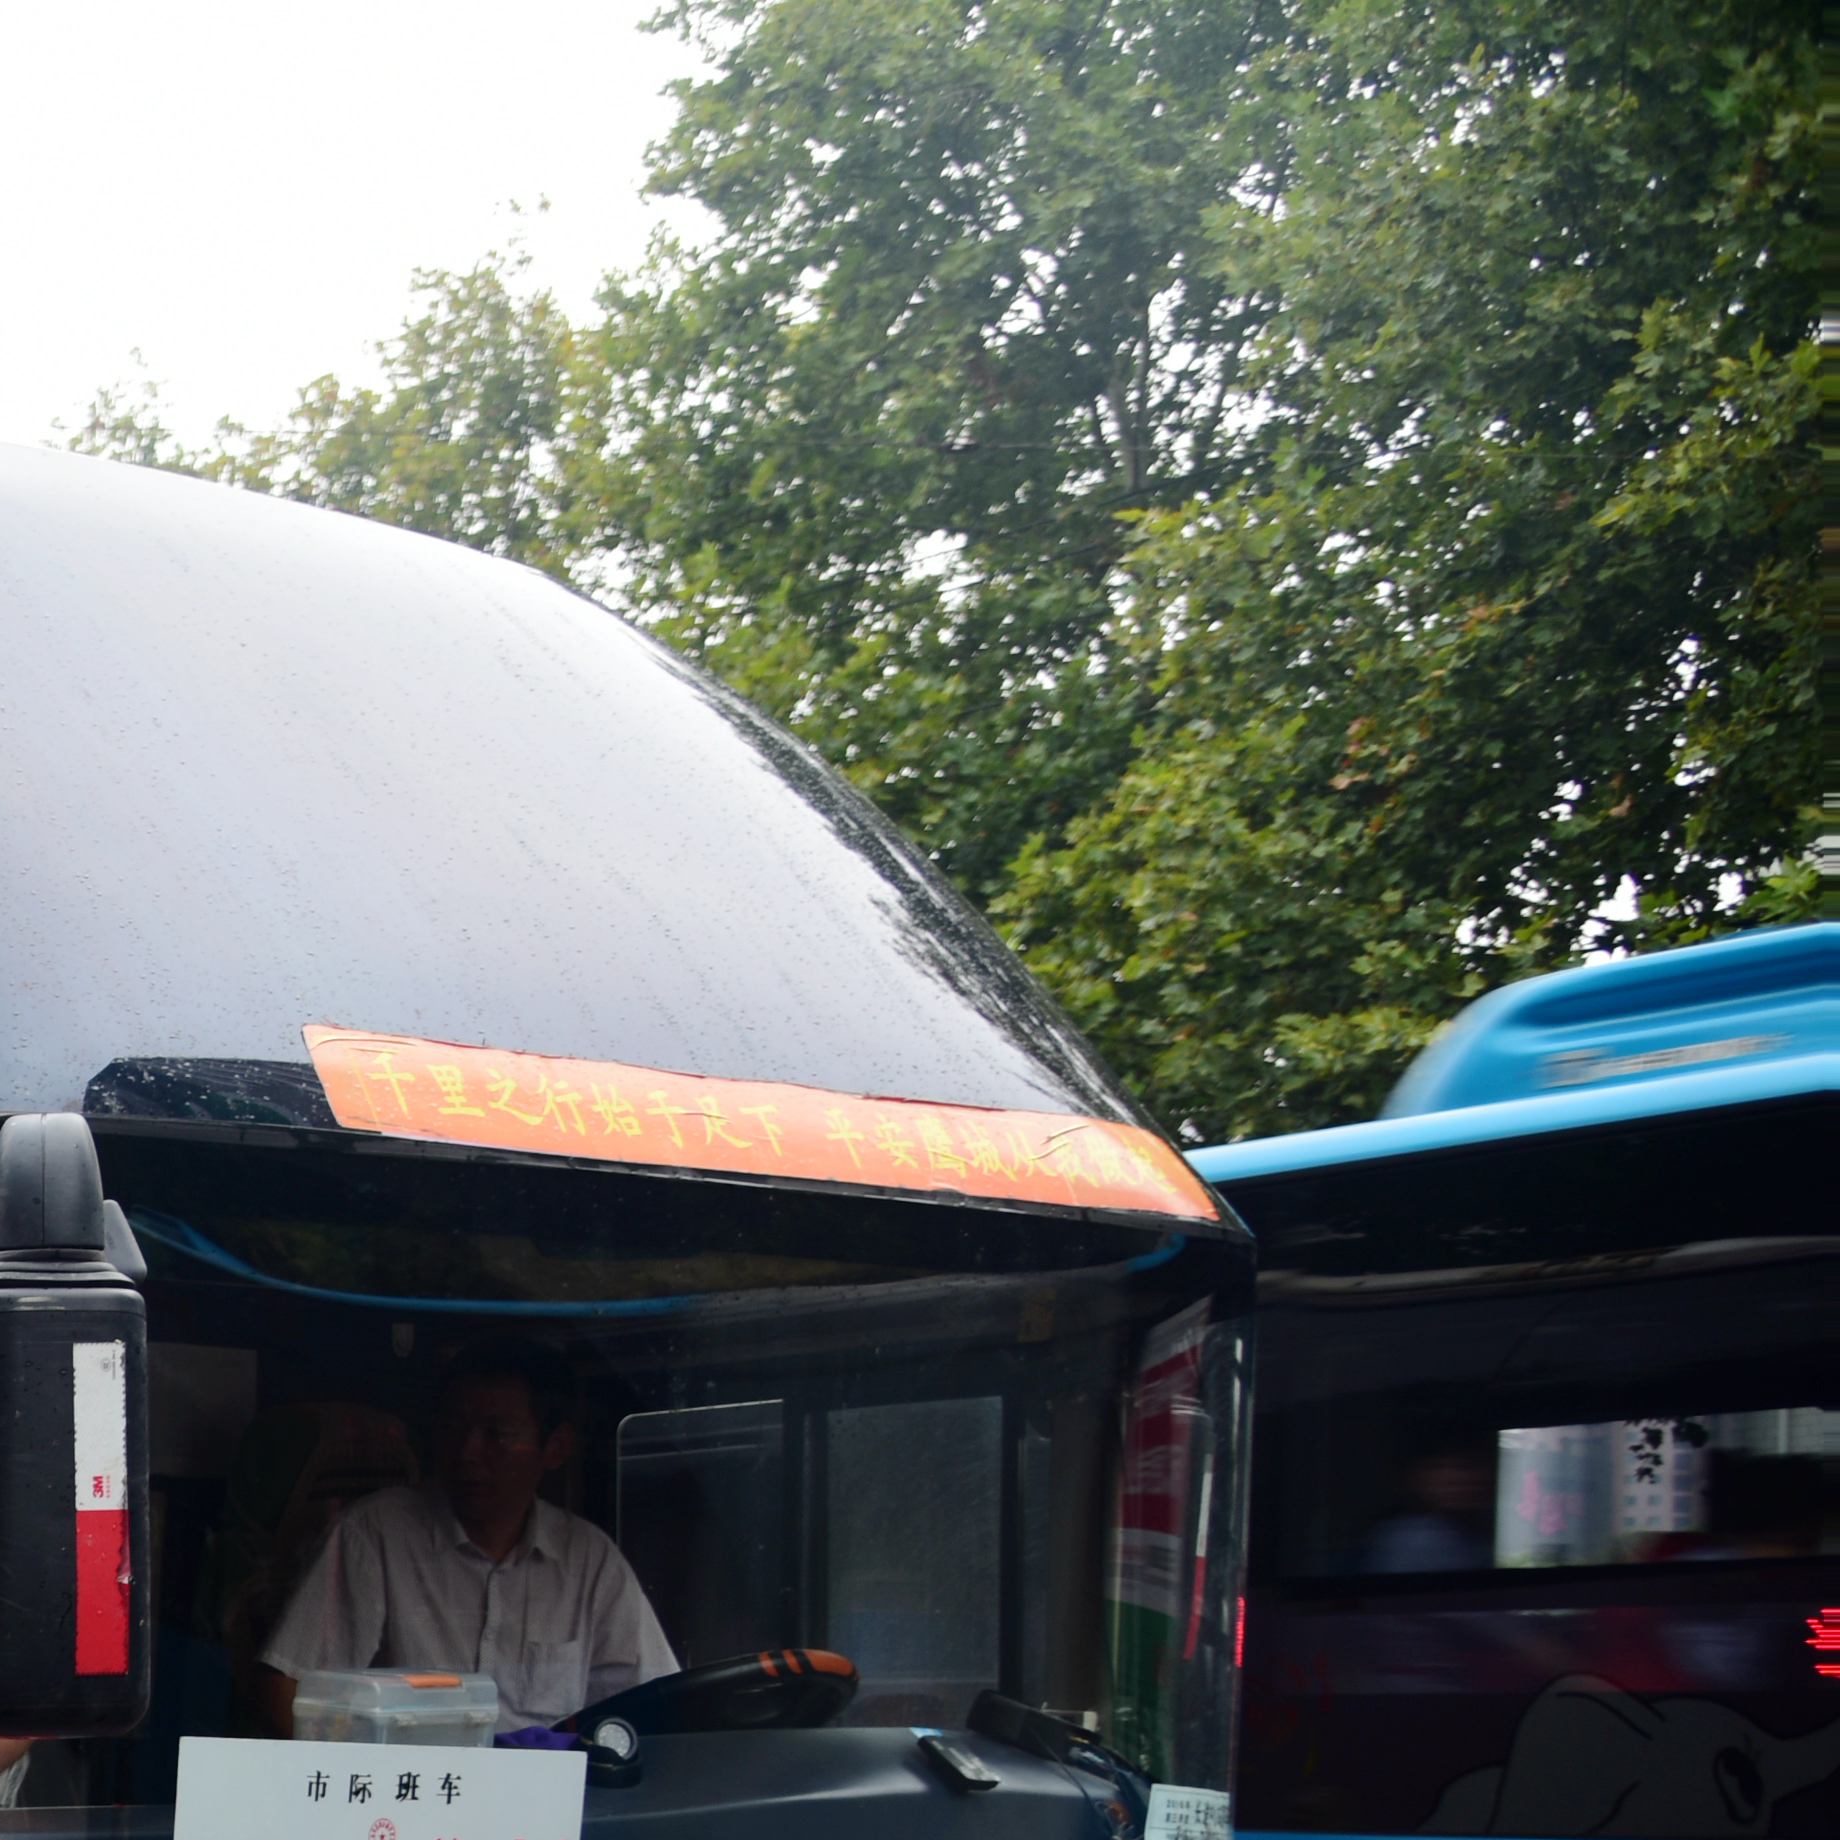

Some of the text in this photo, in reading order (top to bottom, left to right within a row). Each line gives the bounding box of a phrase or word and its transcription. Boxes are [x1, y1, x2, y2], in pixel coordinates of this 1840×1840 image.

[364, 1050, 782, 1157] 千里之行始于足下
[92, 1475, 105, 1499] 3M
[305, 1769, 464, 1805] 市际班车
